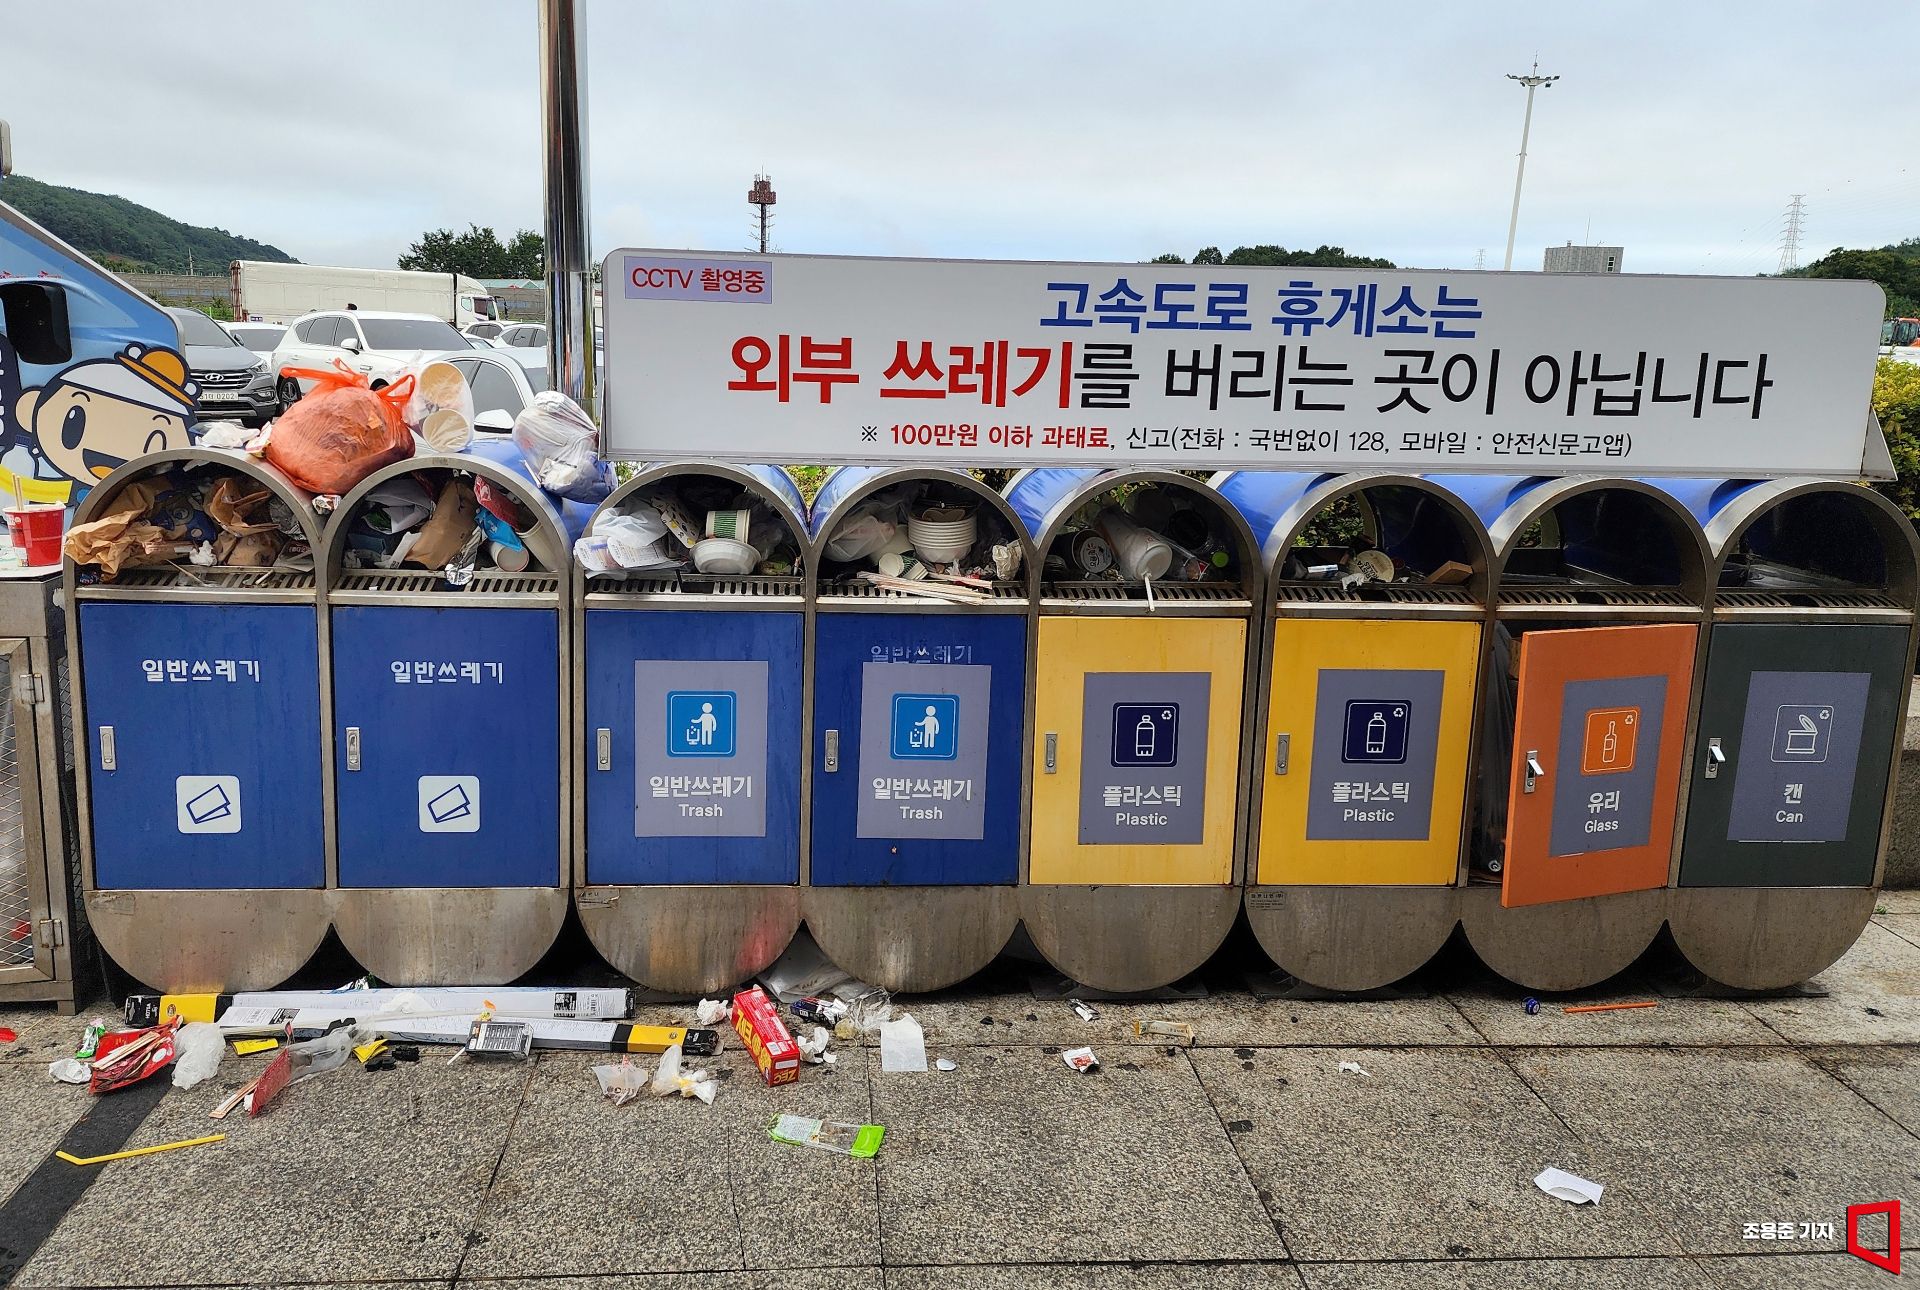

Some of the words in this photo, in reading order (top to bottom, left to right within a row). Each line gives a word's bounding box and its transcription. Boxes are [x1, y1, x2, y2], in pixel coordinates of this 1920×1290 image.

[633, 268, 693, 288] CCTV
[700, 268, 765, 293] 촬영중
[1040, 279, 1252, 333] 고속도로
[1272, 280, 1482, 339] 휴게소는
[727, 335, 860, 404] 외부
[880, 340, 1139, 409] 쓰레기를
[1165, 344, 1354, 411] 버리는
[1374, 349, 1500, 415] 곳이
[1525, 351, 1773, 420] 아닙니다
[891, 424, 978, 447] 100만원
[988, 425, 1033, 448] 이하
[1042, 426, 1114, 450] 과태료,
[1127, 426, 1224, 451] 신고(전화
[1249, 429, 1338, 452] 국번없이
[1349, 432, 1389, 454] 128,
[1400, 432, 1466, 453] 모바일
[1493, 433, 1631, 457] 안전신문고앱)
[142, 660, 259, 682] 일반쓰레기
[391, 661, 502, 683] 일반쓰레기
[650, 776, 751, 798] 일반쓰레기
[872, 778, 972, 801] 일반쓰레기
[1103, 785, 1182, 807] 플라스틱
[1331, 782, 1409, 803] 플라스틱
[1784, 784, 1803, 804] 캔
[679, 804, 723, 817] Trash
[900, 806, 942, 820] Trash
[1588, 791, 1620, 814] 유리
[1116, 813, 1167, 826] Plastic
[1344, 809, 1394, 822] Plastic
[1585, 820, 1618, 833] Glass
[1776, 810, 1803, 823] Can
